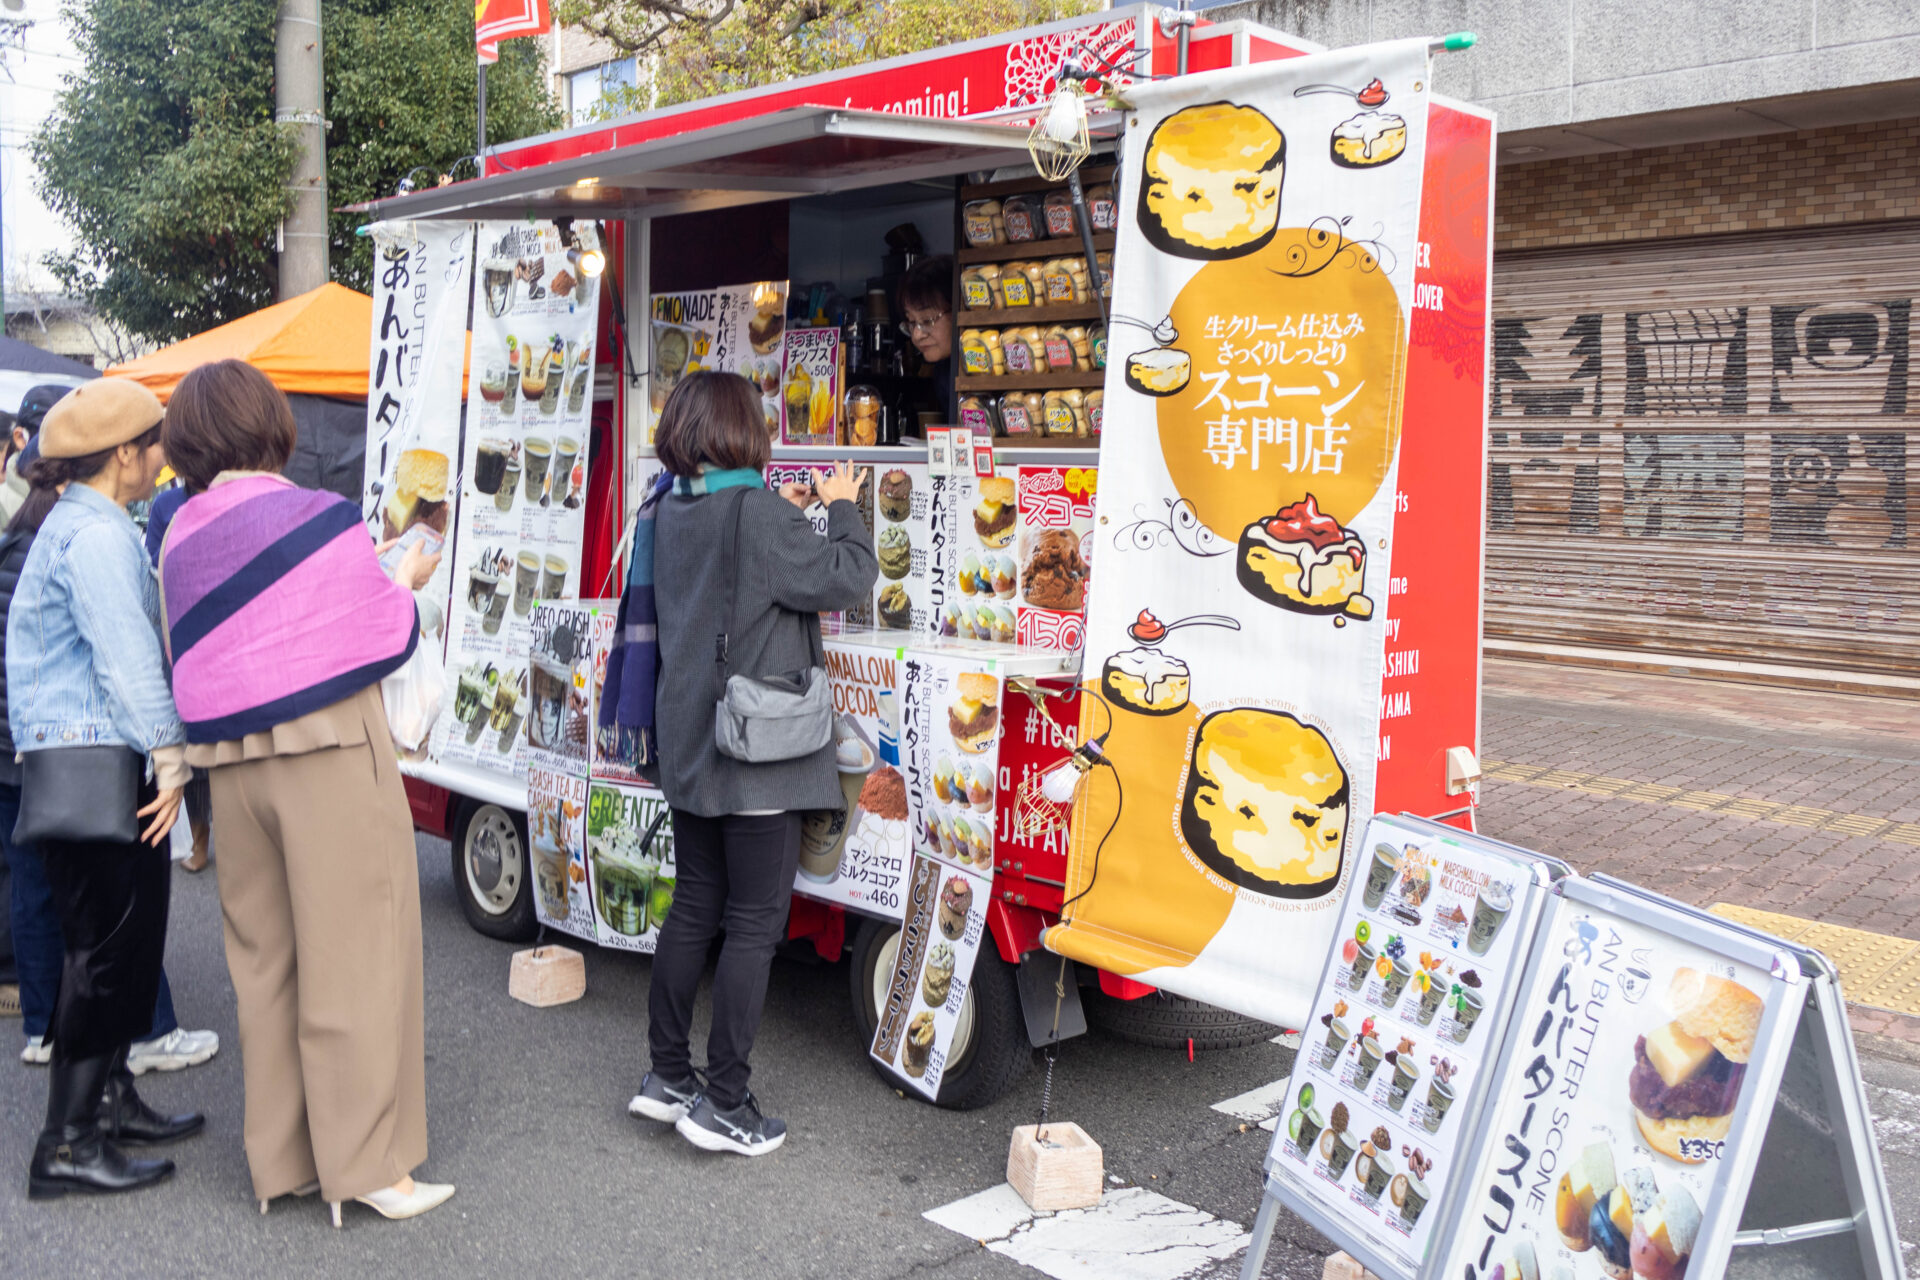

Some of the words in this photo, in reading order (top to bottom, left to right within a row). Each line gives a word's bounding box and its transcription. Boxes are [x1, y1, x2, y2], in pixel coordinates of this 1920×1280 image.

[414, 239, 427, 275] AN
[651, 293, 717, 325] LEMONADE
[730, 293, 738, 309] AN
[410, 284, 426, 388] BUTTER
[729, 311, 738, 354] BUTTER
[786, 331, 837, 350] さつまいも
[1204, 313, 1365, 340] 生クリーム仕込み
[790, 347, 829, 364] チップス
[1217, 340, 1347, 367] さっくりしっとり
[1193, 369, 1366, 418] スコーン
[1202, 415, 1351, 475] 専門店
[948, 494, 957, 544] BUTTER
[1022, 495, 1097, 528] スコー
[948, 549, 957, 591] SCONE
[924, 663, 933, 687] AN
[829, 683, 880, 719] OCOA
[921, 688, 932, 744] BUTTER
[1195, 700, 1225, 720] scone
[1228, 696, 1261, 706] scone
[1264, 697, 1298, 713] scone
[1302, 712, 1333, 735] scone
[904, 660, 929, 846] あんバタースコーン
[1184, 725, 1196, 762] scone
[1332, 736, 1352, 770] scone
[555, 775, 570, 798] TEA
[921, 748, 932, 796] SCONE
[1176, 763, 1188, 801] scone
[1350, 773, 1358, 815] scone
[1172, 802, 1184, 844] scone
[840, 860, 900, 890] ミルクココア
[850, 848, 902, 873] マシュマロ
[1181, 845, 1205, 874] scone
[1442, 860, 1492, 888] MARSHMALLOW
[1205, 871, 1234, 894] scone
[1338, 859, 1351, 898] scone
[1439, 873, 1453, 892] MILK
[1453, 877, 1478, 900] COCOA
[1269, 901, 1302, 913] scone
[1305, 897, 1337, 912] scone
[1597, 926, 1623, 974] AN
[1559, 978, 1611, 1100] BUTTER
[1525, 1106, 1570, 1216] SCONE
